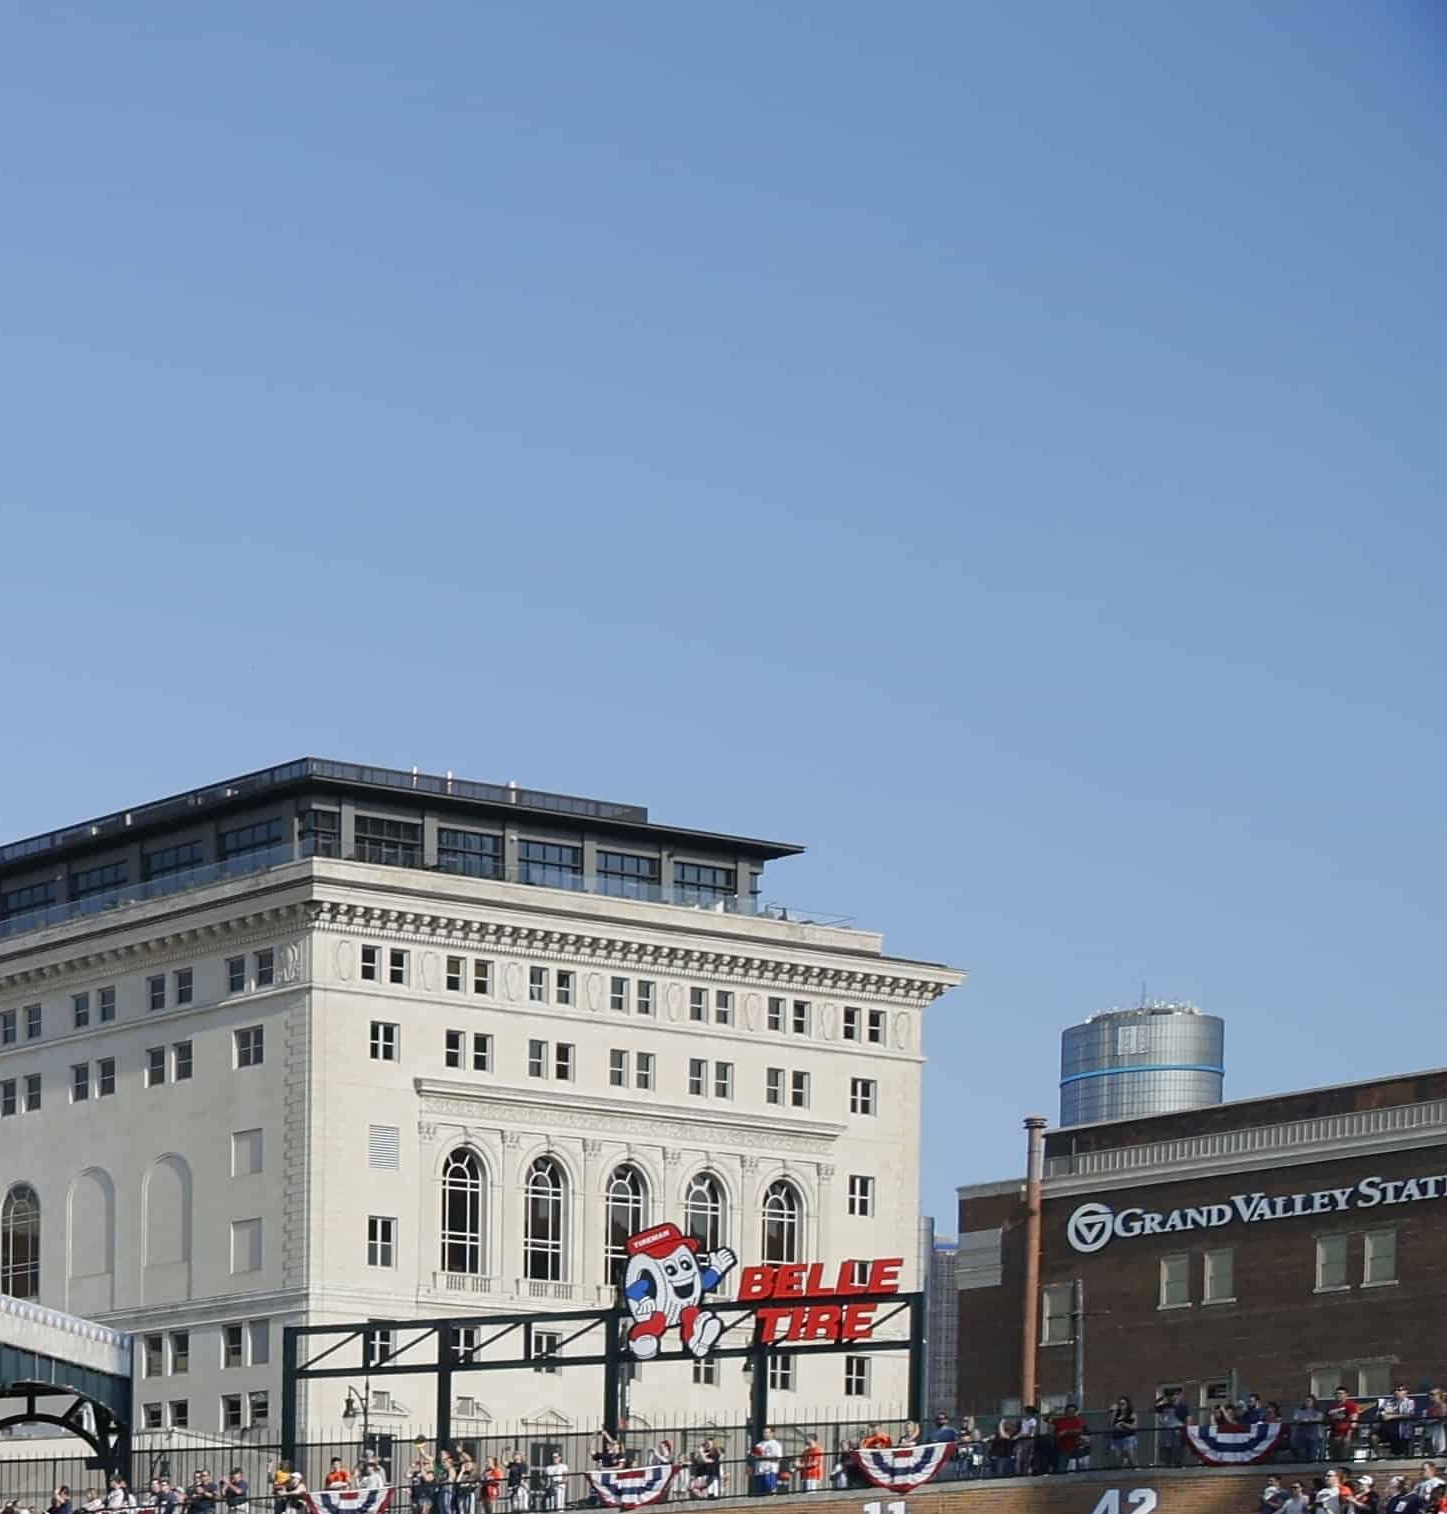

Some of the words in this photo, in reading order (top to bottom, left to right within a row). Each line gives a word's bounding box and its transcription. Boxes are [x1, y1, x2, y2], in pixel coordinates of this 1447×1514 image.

[1113, 1204, 1234, 1238] GRAND
[1230, 1187, 1355, 1223] VALLEY
[738, 1258, 904, 1302] BELLE
[756, 1303, 878, 1344] TIRE
